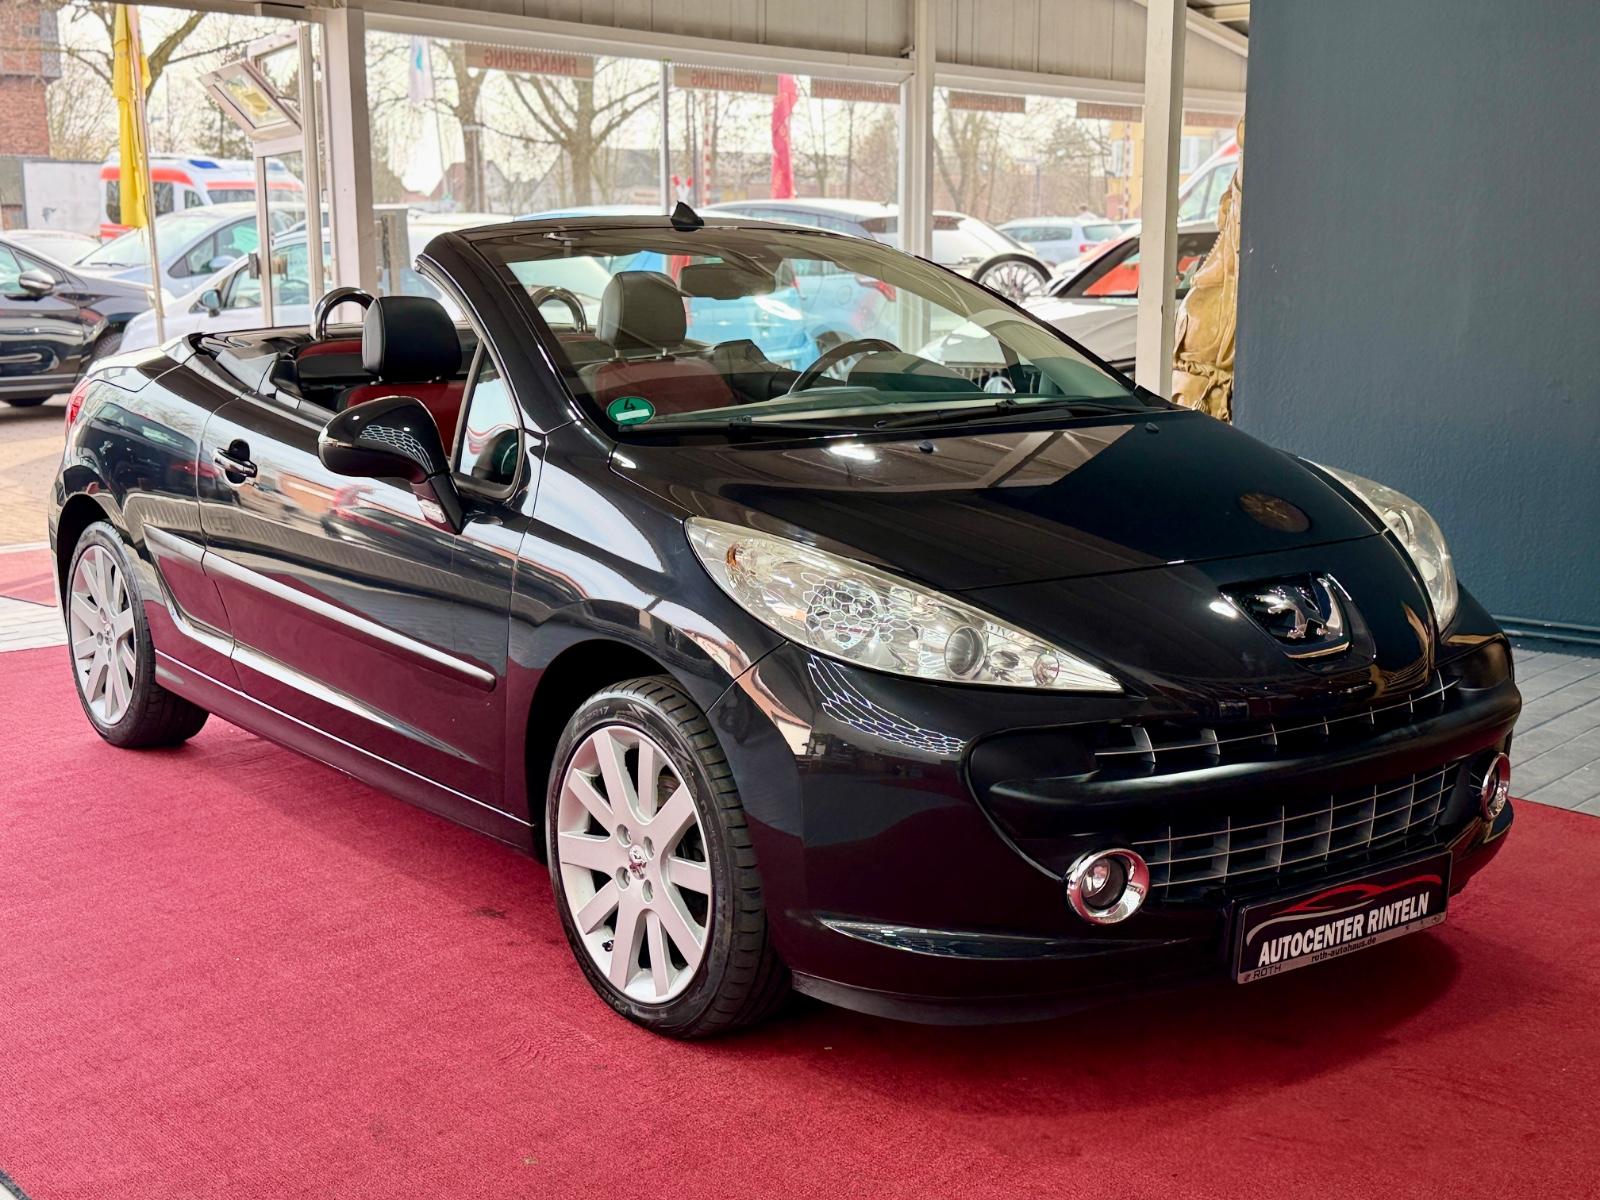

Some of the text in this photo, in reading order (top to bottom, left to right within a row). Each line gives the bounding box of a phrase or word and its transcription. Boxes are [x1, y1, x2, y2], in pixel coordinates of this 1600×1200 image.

[1257, 892, 1429, 967] AUTOCENTER RINTELN
[1311, 936, 1377, 962] roth-autohaus.de
